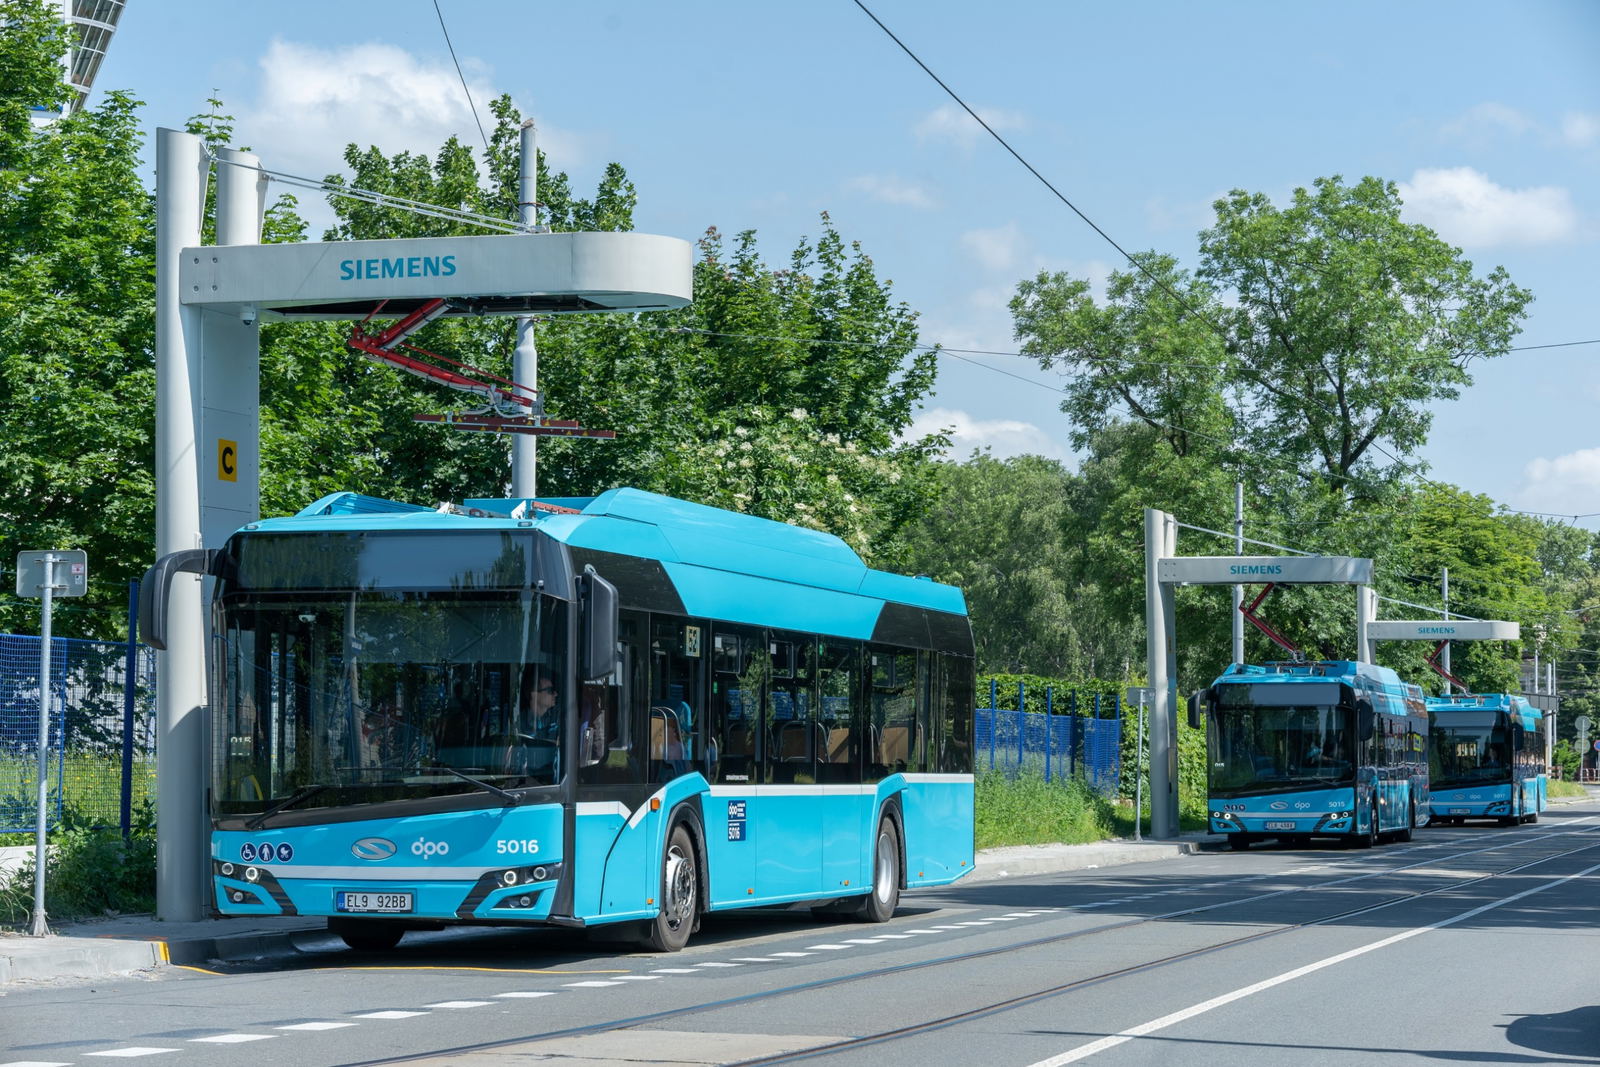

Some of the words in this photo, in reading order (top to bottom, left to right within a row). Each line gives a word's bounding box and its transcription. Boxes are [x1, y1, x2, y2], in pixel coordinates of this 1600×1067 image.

[340, 255, 456, 281] SIEMENS
[222, 446, 234, 475] C
[1230, 565, 1282, 575] SIEMENS
[1294, 801, 1311, 810] dpo
[729, 827, 740, 839] 5016
[411, 837, 449, 860] dpo
[497, 840, 539, 854] 5016
[347, 895, 368, 908] EL9
[377, 895, 406, 909] 92BB
